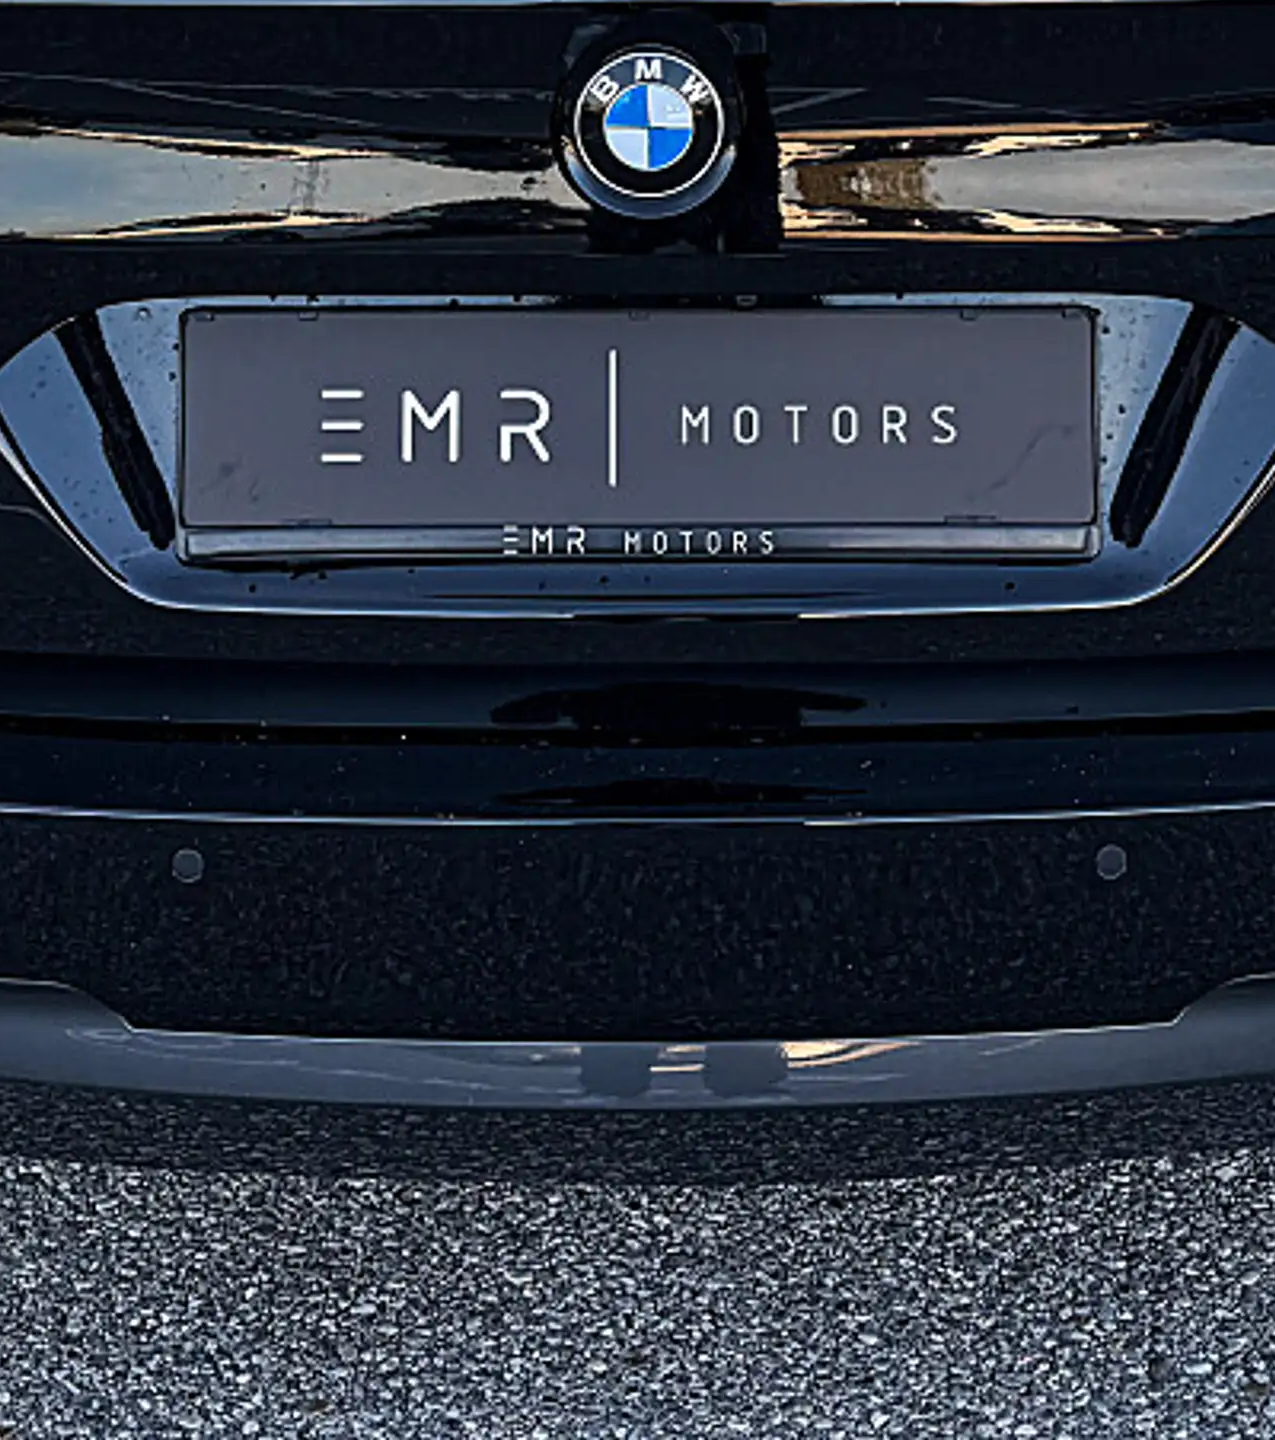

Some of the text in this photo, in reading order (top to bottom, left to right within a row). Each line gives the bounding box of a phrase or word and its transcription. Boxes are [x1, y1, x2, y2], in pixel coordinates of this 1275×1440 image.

[588, 58, 711, 104] BMW
[320, 389, 960, 463] EMR MOTORS
[503, 525, 775, 555] EMR MOTORS
